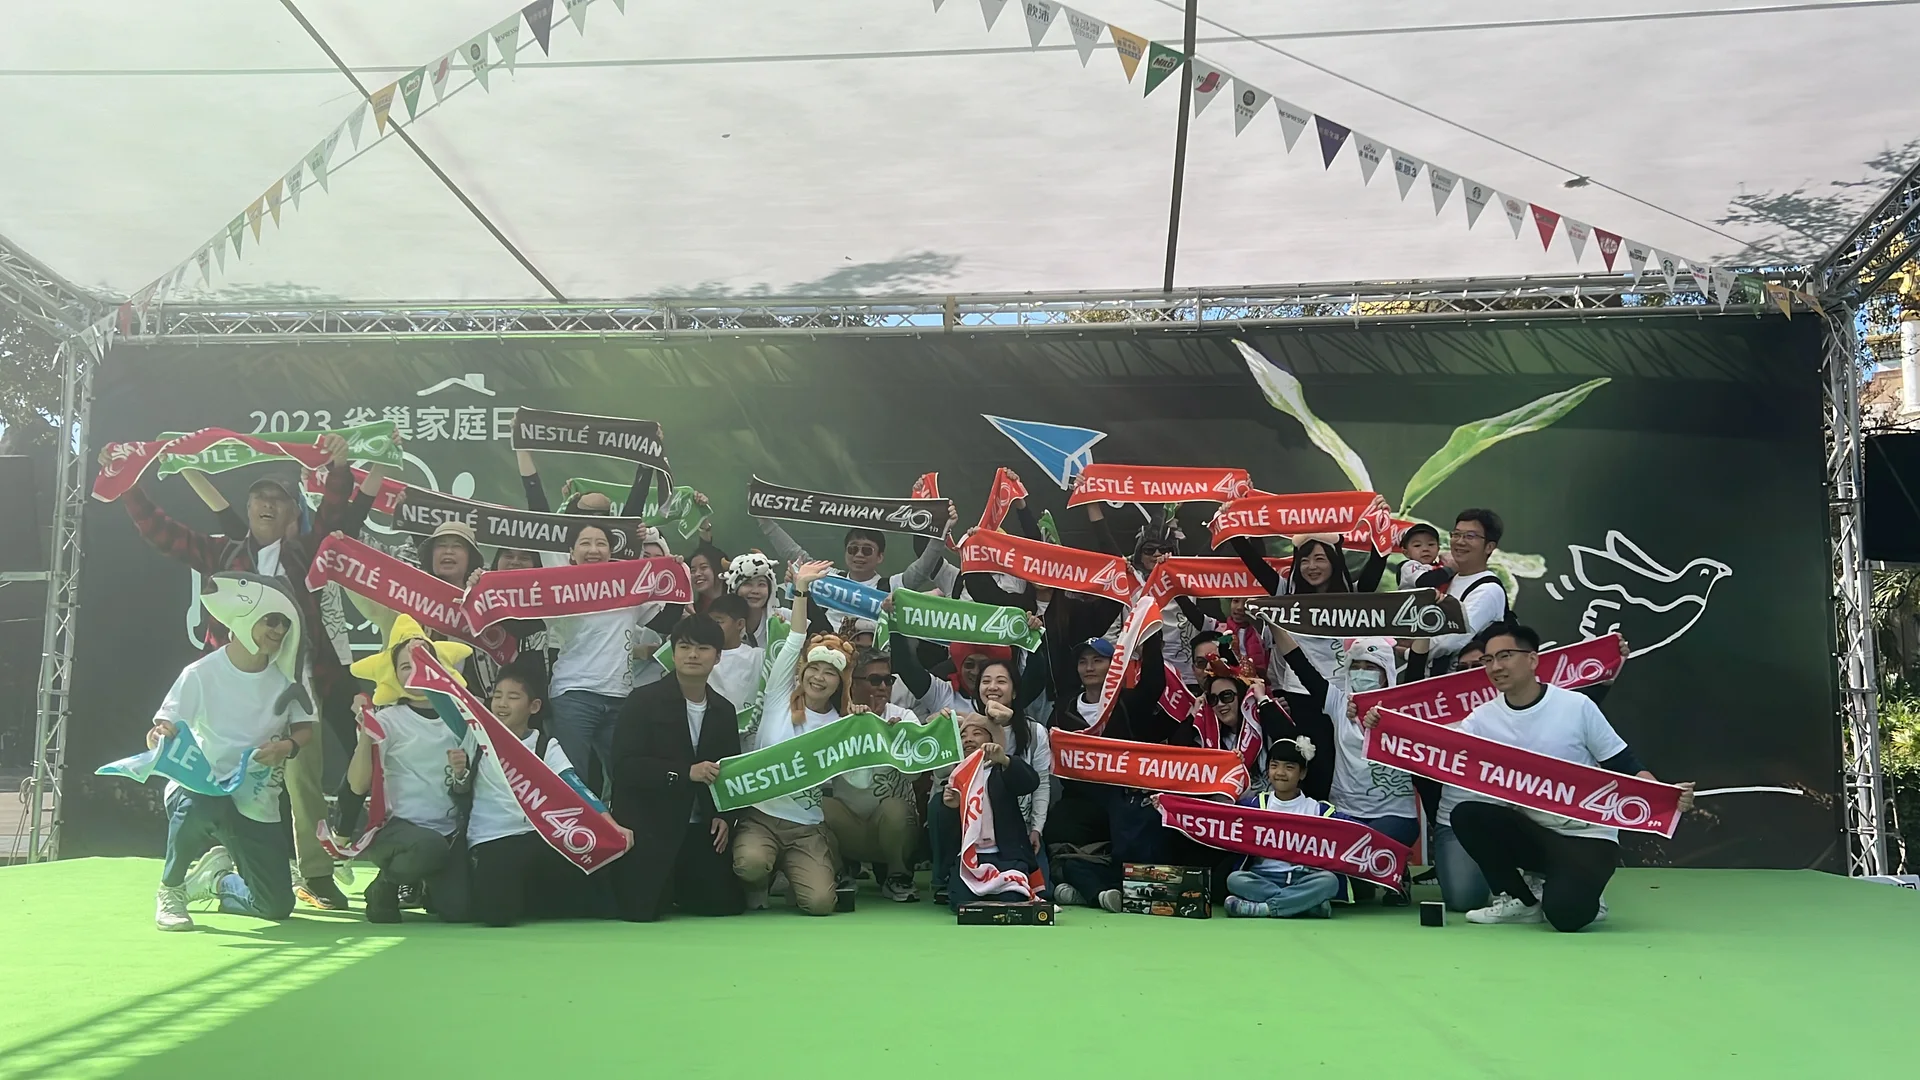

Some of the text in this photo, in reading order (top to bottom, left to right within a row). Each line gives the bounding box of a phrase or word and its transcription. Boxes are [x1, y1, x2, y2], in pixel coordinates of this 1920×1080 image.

[520, 423, 662, 458] NESTLÉ TAIWAN
[1075, 475, 1134, 495] NESTLÉ
[1141, 481, 1208, 496] TAIWAN
[751, 492, 814, 513] NESTLÉ
[819, 501, 885, 521] TAIWAN
[1277, 506, 1354, 525] TAIWAN
[487, 516, 568, 543] TAIWAN
[962, 545, 1016, 569] NESTLÉ
[1023, 556, 1088, 583] TAIWAN
[1176, 572, 1248, 588] TAIWAN
[316, 549, 381, 590] NESTLÉ
[387, 579, 462, 629] TAIWAN
[474, 580, 543, 616] NESTLÉ
[550, 578, 626, 604] TAIWAN
[809, 578, 863, 608] ESTLÉ
[902, 606, 977, 631] TAIWAN
[1309, 608, 1386, 629] TAIWAN
[725, 751, 808, 799] NESTLÉ
[813, 733, 889, 769] TAIWAN
[1060, 749, 1130, 775] NESTLÉ
[1137, 757, 1218, 784] TAIWAN
[1380, 732, 1468, 777] NESTLÉ
[1478, 760, 1576, 805] TAIWAN
[1253, 825, 1337, 859] TAIWAN
